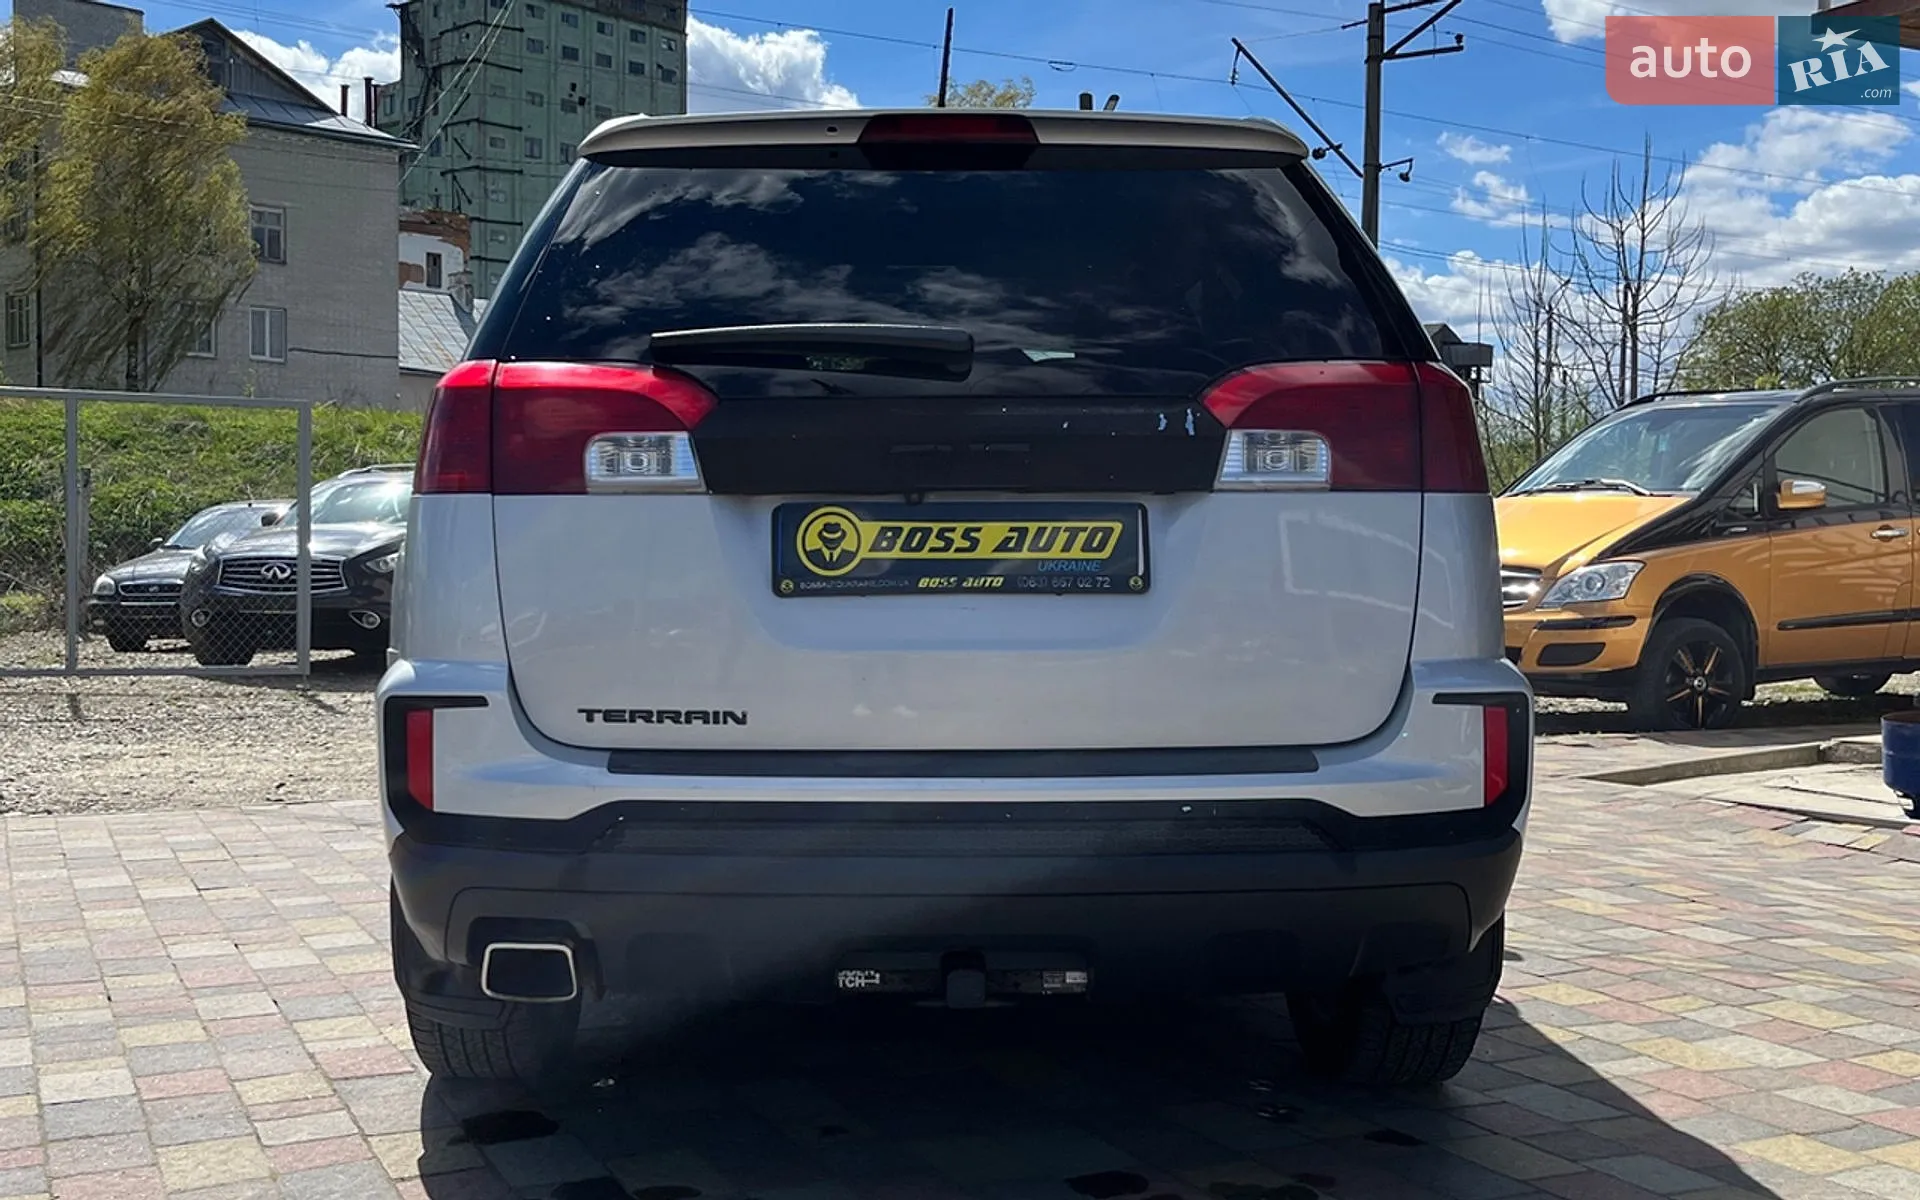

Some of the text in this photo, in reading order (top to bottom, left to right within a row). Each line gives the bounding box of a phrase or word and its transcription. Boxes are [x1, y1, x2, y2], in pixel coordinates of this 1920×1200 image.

[868, 526, 1115, 553] BOSS AUTO
[1037, 560, 1101, 572] UKRAINE
[917, 576, 1004, 588] BOSS AUTO
[1096, 576, 1112, 588] 72
[577, 708, 748, 725] TERRAIN
